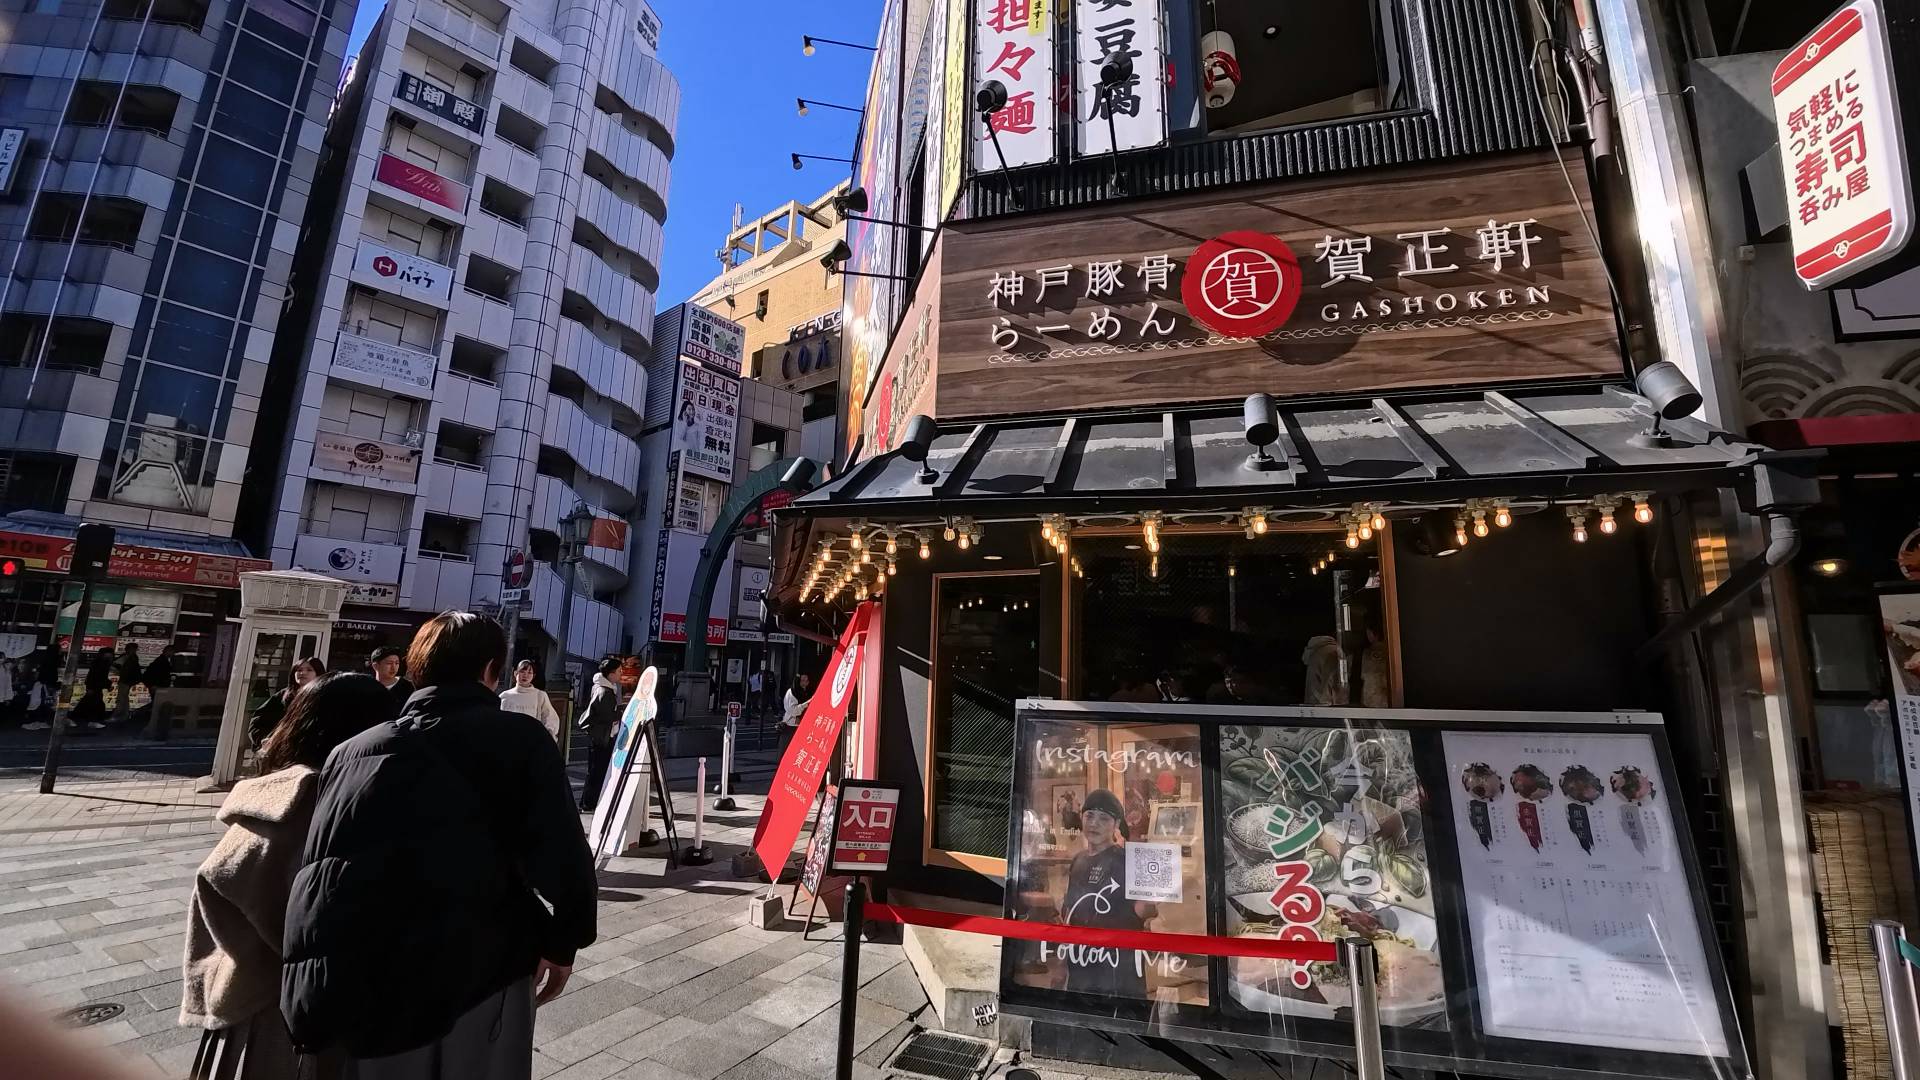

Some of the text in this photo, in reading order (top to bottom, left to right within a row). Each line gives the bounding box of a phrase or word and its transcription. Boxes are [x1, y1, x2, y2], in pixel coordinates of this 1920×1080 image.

[1088, 0, 1142, 121] 豆腐
[422, 86, 476, 122] 御殿
[1786, 69, 1860, 139] 気軽に
[1790, 97, 1864, 156] つまめる
[1795, 121, 1867, 197] 寿司
[1799, 166, 1871, 226] 呑み屋
[1315, 218, 1542, 289] 賀正軒
[987, 254, 1176, 307] 神戸豚骨
[1203, 252, 1282, 317] 賀
[1320, 286, 1551, 322] GASHOKEN
[991, 302, 1176, 350] らーめん
[684, 366, 737, 396] 出張買取
[683, 389, 735, 417] 即日現金
[706, 414, 732, 428] 出張料
[704, 435, 730, 455] 無料
[651, 559, 665, 630] おたからや
[347, 623, 377, 631] BAKERY
[1035, 739, 1199, 773] Instagram
[842, 804, 892, 829] 入口
[1040, 940, 1187, 977] Follow Me
